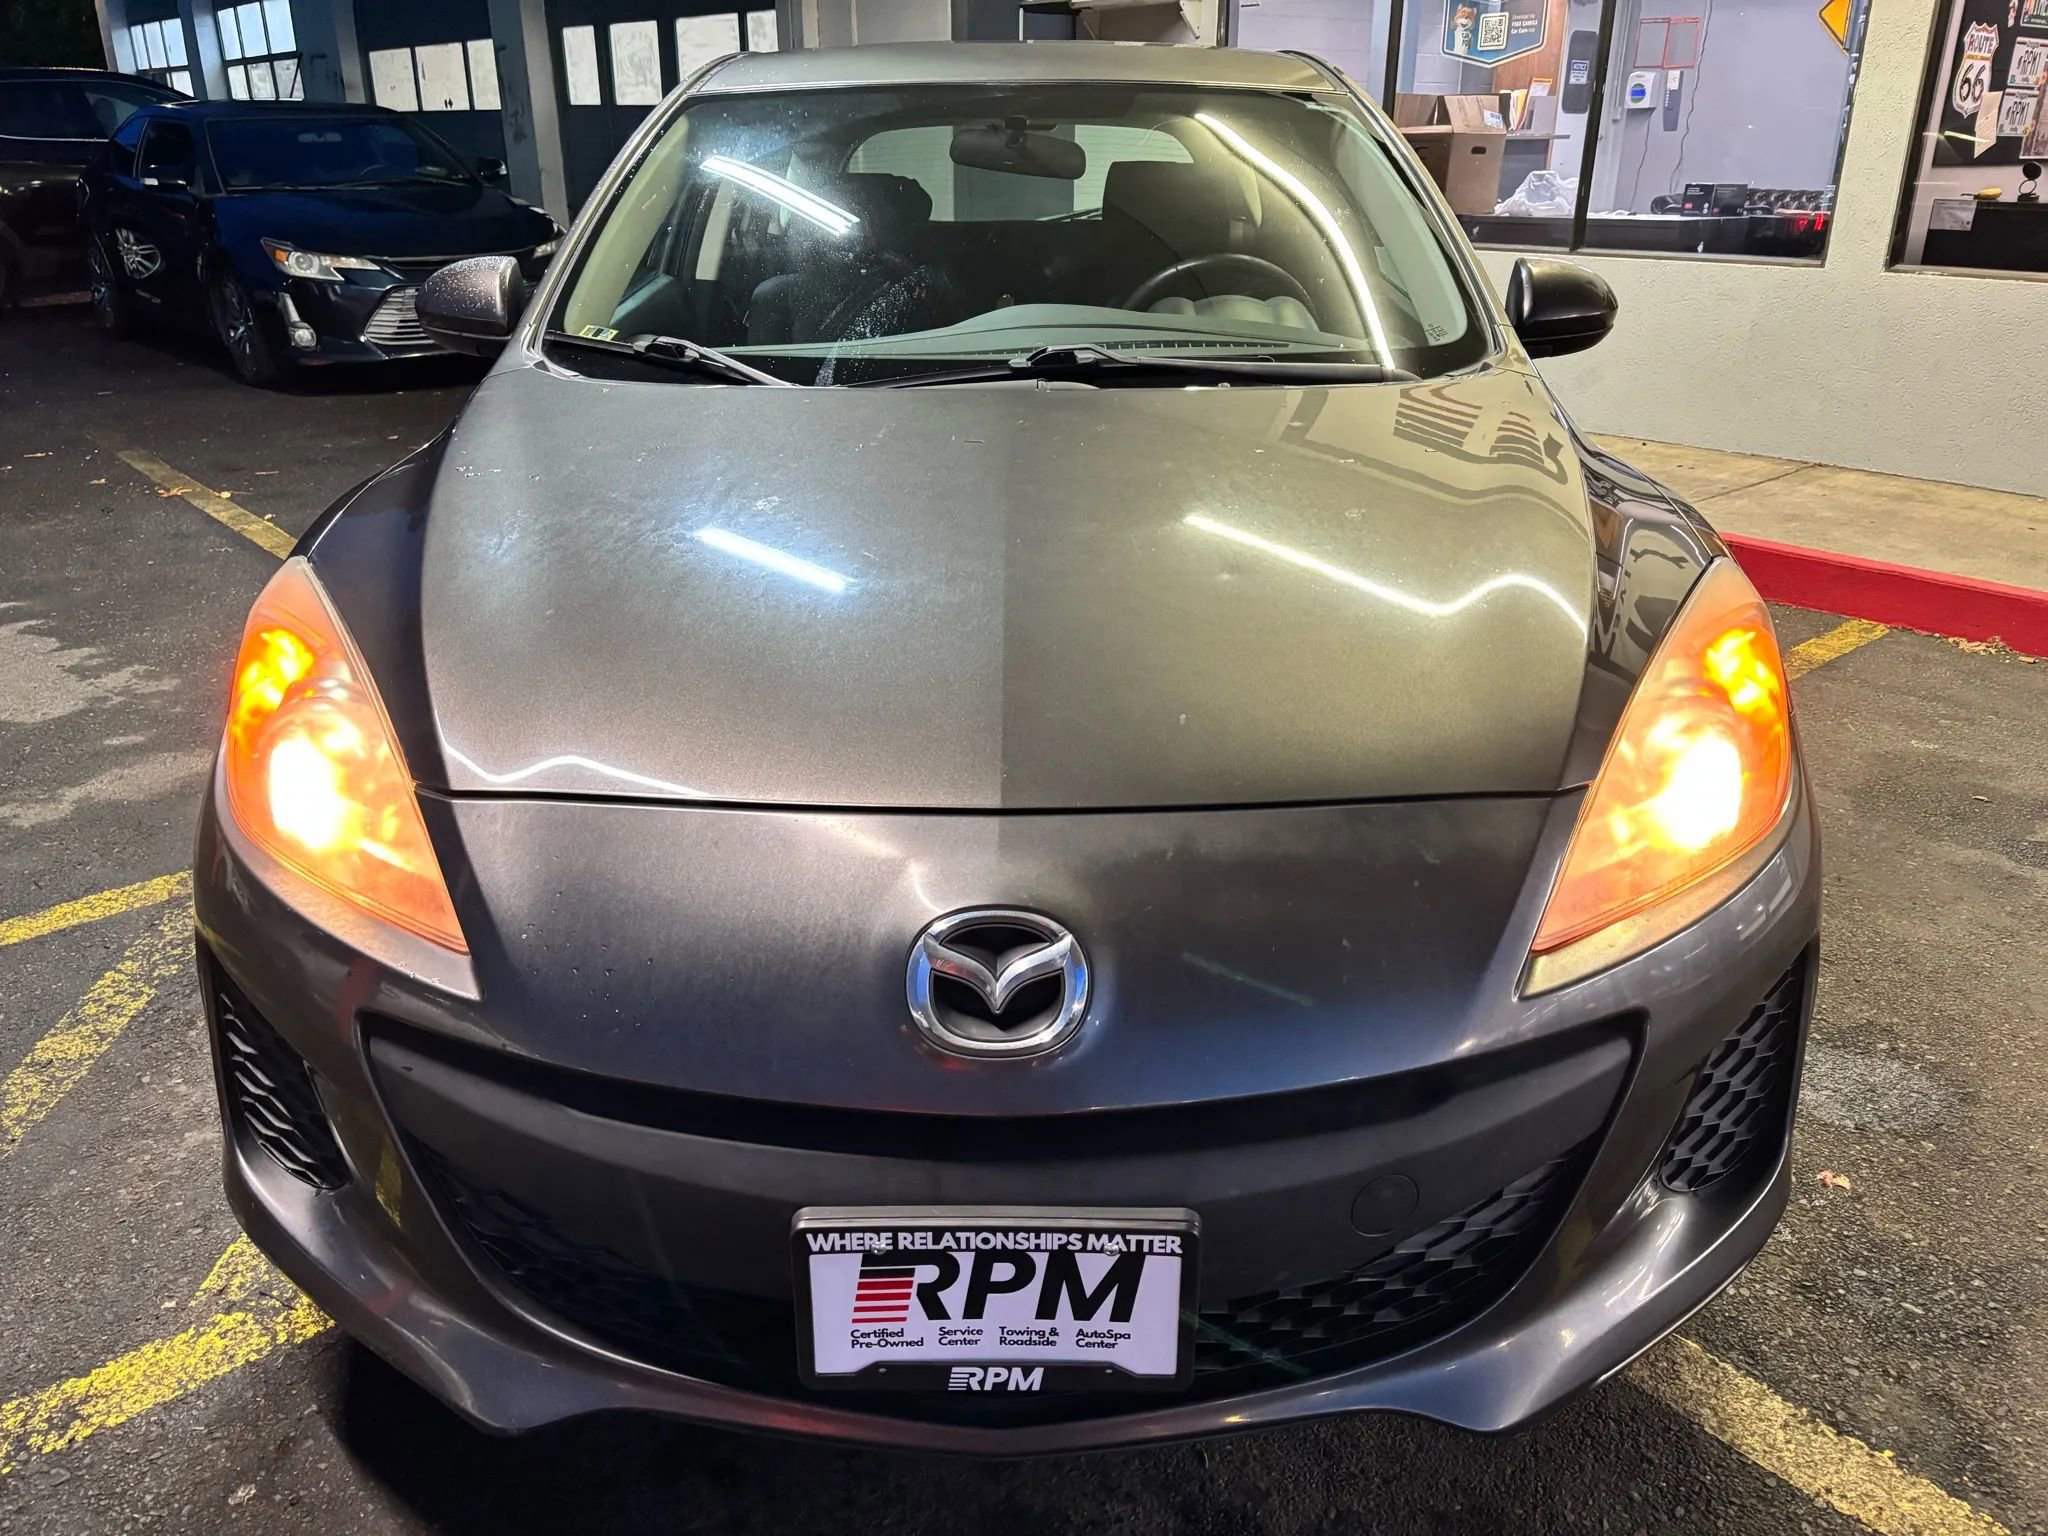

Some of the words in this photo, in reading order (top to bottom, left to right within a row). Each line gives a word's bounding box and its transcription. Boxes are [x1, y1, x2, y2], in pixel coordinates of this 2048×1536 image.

[1968, 33, 1995, 54] ROUTE
[1960, 63, 1986, 103] 66
[806, 1232, 893, 1253] WHERE
[897, 1231, 1082, 1252] RELATIONSHIPS
[1087, 1233, 1183, 1254] MATTER
[851, 1252, 1147, 1324] RPM
[850, 1327, 905, 1339] Certified
[938, 1326, 984, 1337] Service
[999, 1326, 1047, 1339] Towing
[1049, 1327, 1060, 1338] &
[1075, 1329, 1132, 1342] AutoSpa
[850, 1338, 924, 1349] Pre-Owned
[938, 1336, 981, 1347] Center
[999, 1335, 1058, 1347] Roadside
[1075, 1338, 1119, 1349] Center
[948, 1367, 1044, 1392] RPM
